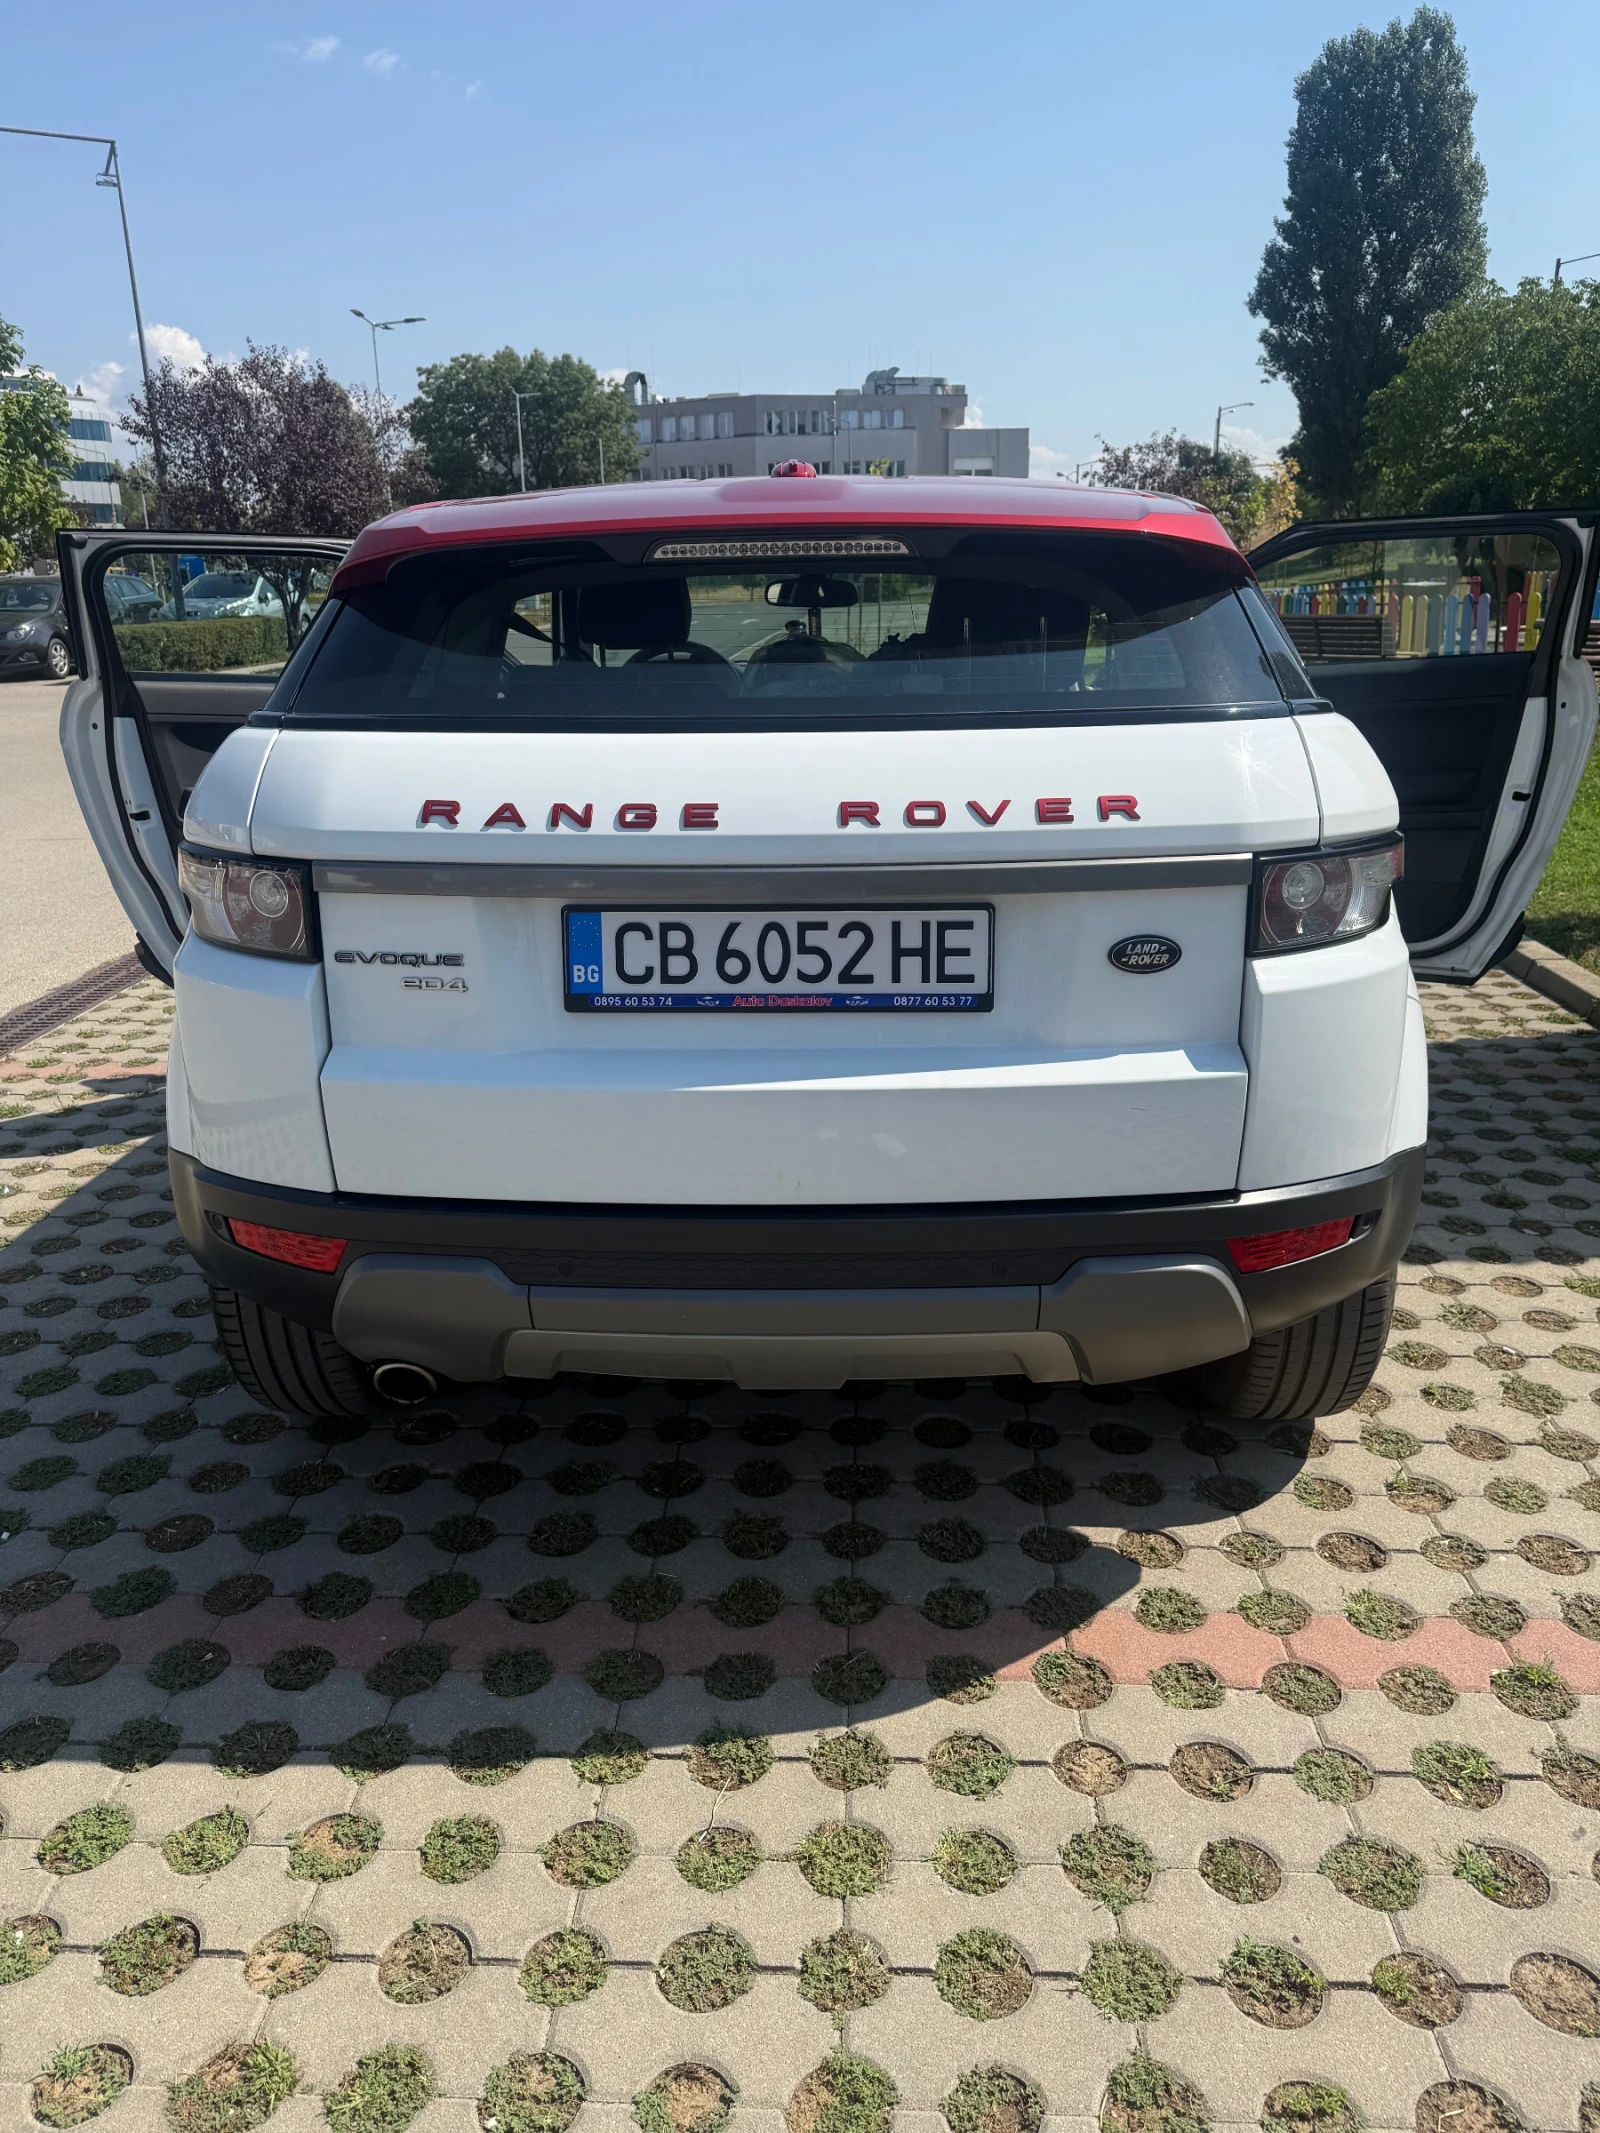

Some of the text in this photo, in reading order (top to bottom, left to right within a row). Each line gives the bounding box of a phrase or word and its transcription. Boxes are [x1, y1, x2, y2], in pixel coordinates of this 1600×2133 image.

[421, 795, 1141, 828] RANGE ROVER
[615, 920, 975, 984] CB 6052 HE
[1126, 943, 1160, 955] LAND
[334, 951, 465, 967] EVOQUE
[1128, 953, 1170, 965] ROVER
[573, 964, 599, 983] BG
[594, 996, 673, 1006] 0895 60 53 74
[732, 995, 833, 1007] Auto Daskalov
[893, 996, 972, 1006] 0877 60 53 77
